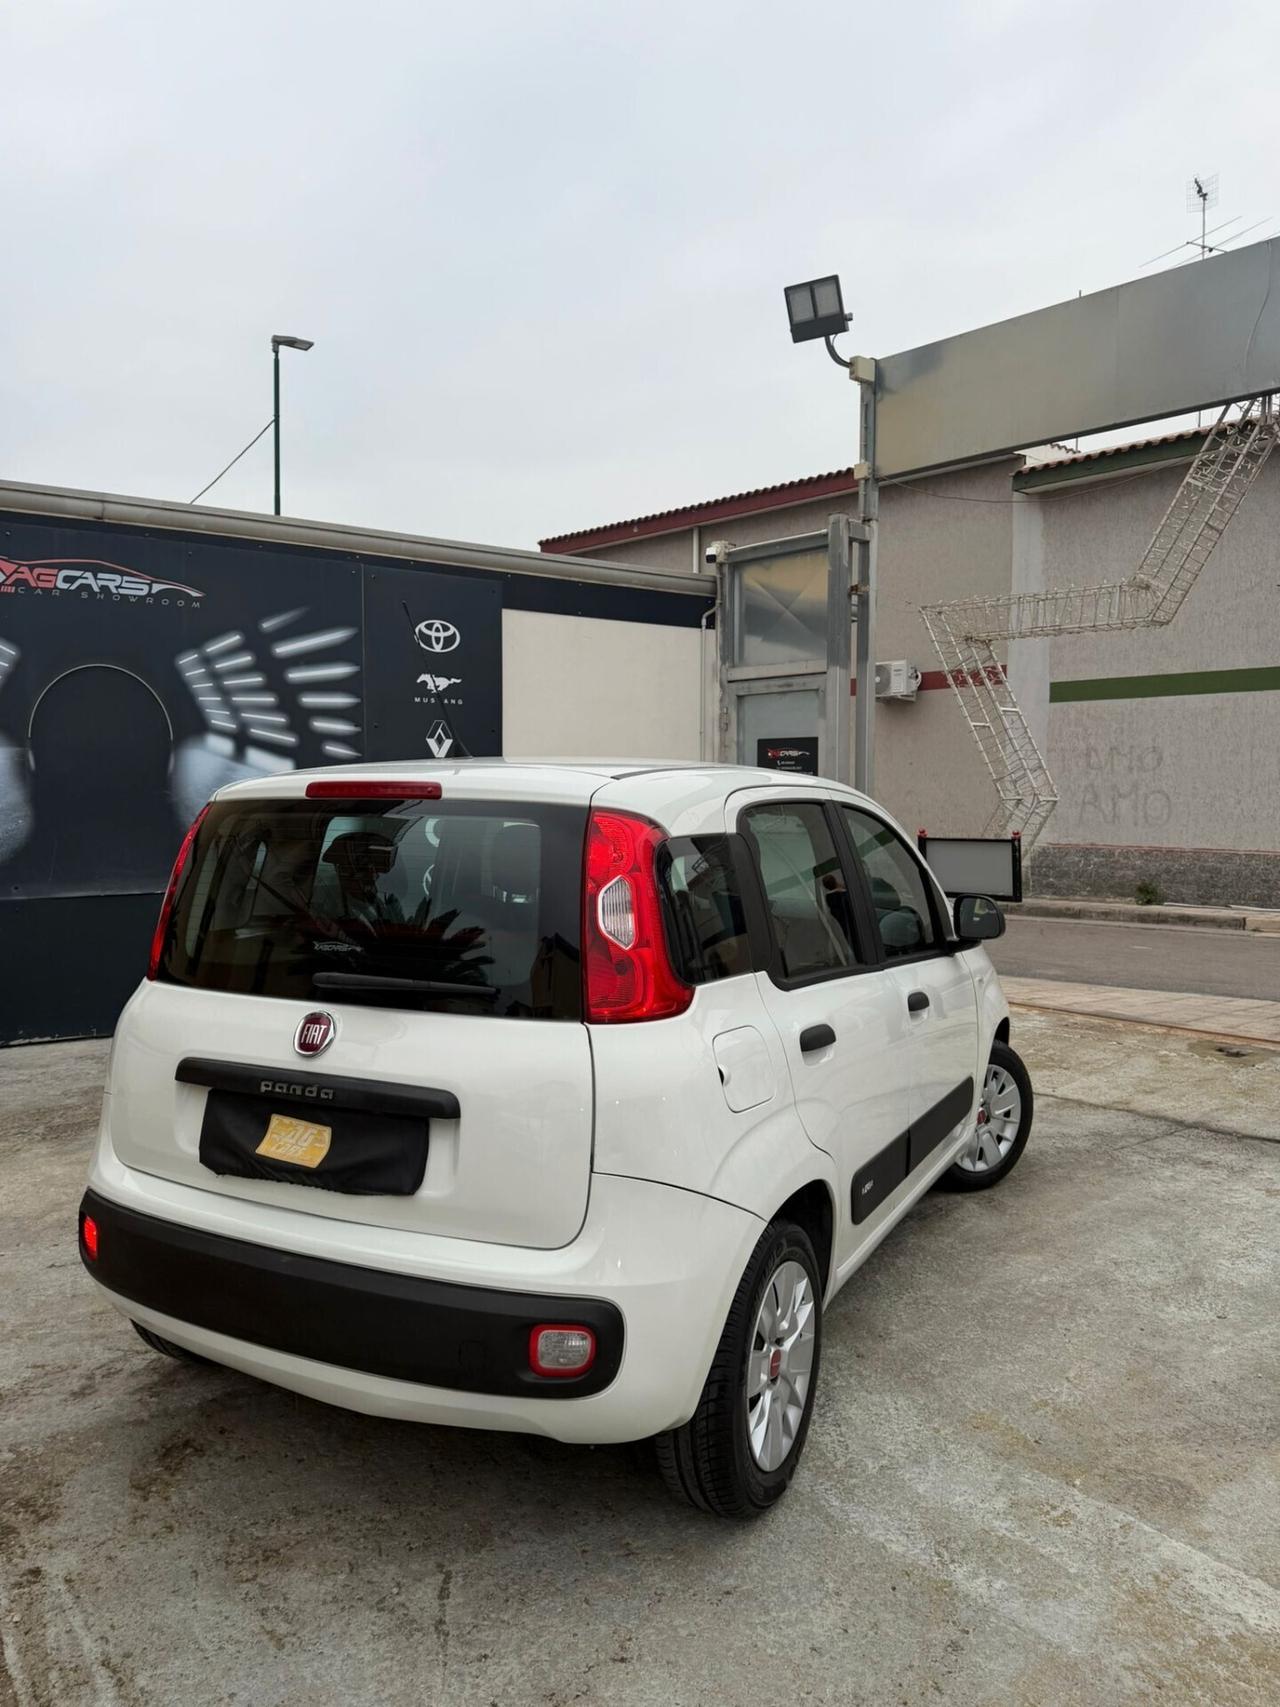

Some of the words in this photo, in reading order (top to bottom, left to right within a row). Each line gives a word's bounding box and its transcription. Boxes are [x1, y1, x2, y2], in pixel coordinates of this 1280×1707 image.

[17, 586, 60, 596] CAR
[81, 591, 200, 608] SHOWROOM
[414, 697, 463, 705] MUSANG
[300, 1023, 328, 1045] FIAT
[260, 1081, 334, 1100] panda
